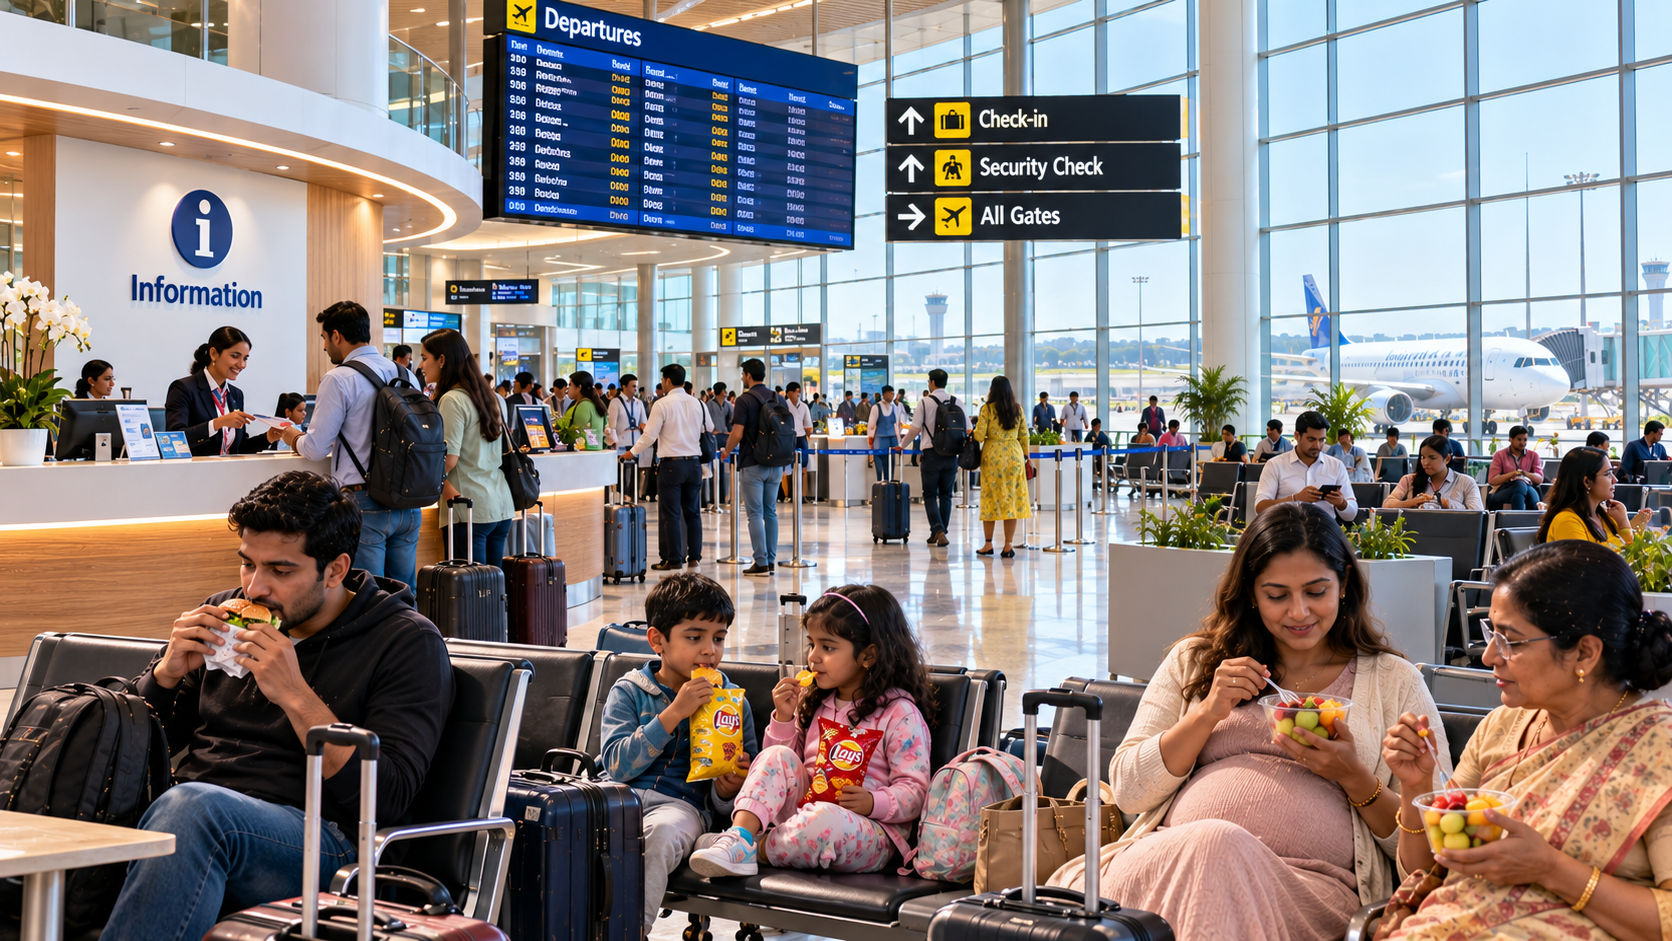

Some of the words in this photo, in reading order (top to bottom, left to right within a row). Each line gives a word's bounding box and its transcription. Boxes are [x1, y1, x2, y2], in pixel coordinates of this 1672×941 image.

[545, 6, 641, 47] Departures
[979, 109, 1048, 129] Check-in
[980, 157, 1048, 180] Security
[1053, 156, 1104, 176] Check
[980, 205, 1004, 225] All
[1010, 206, 1061, 225] Gates
[131, 274, 263, 309] Information
